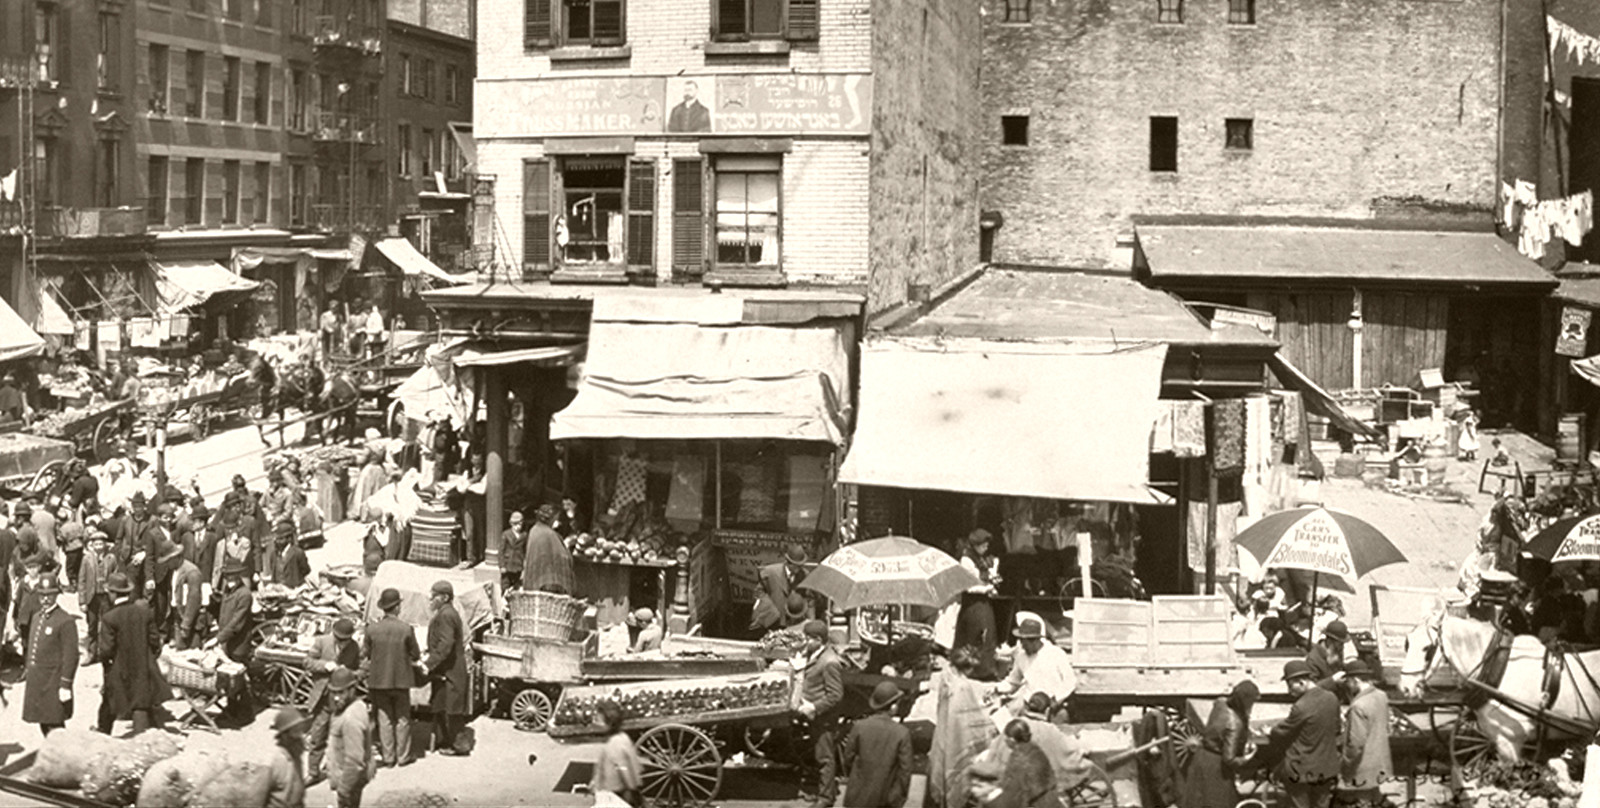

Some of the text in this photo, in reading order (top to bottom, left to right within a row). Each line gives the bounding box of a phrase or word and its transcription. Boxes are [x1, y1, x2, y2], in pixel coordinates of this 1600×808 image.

[565, 112, 637, 131] MAKER.
[1302, 522, 1331, 533] CARS
[1294, 528, 1340, 545] TRANSFER
